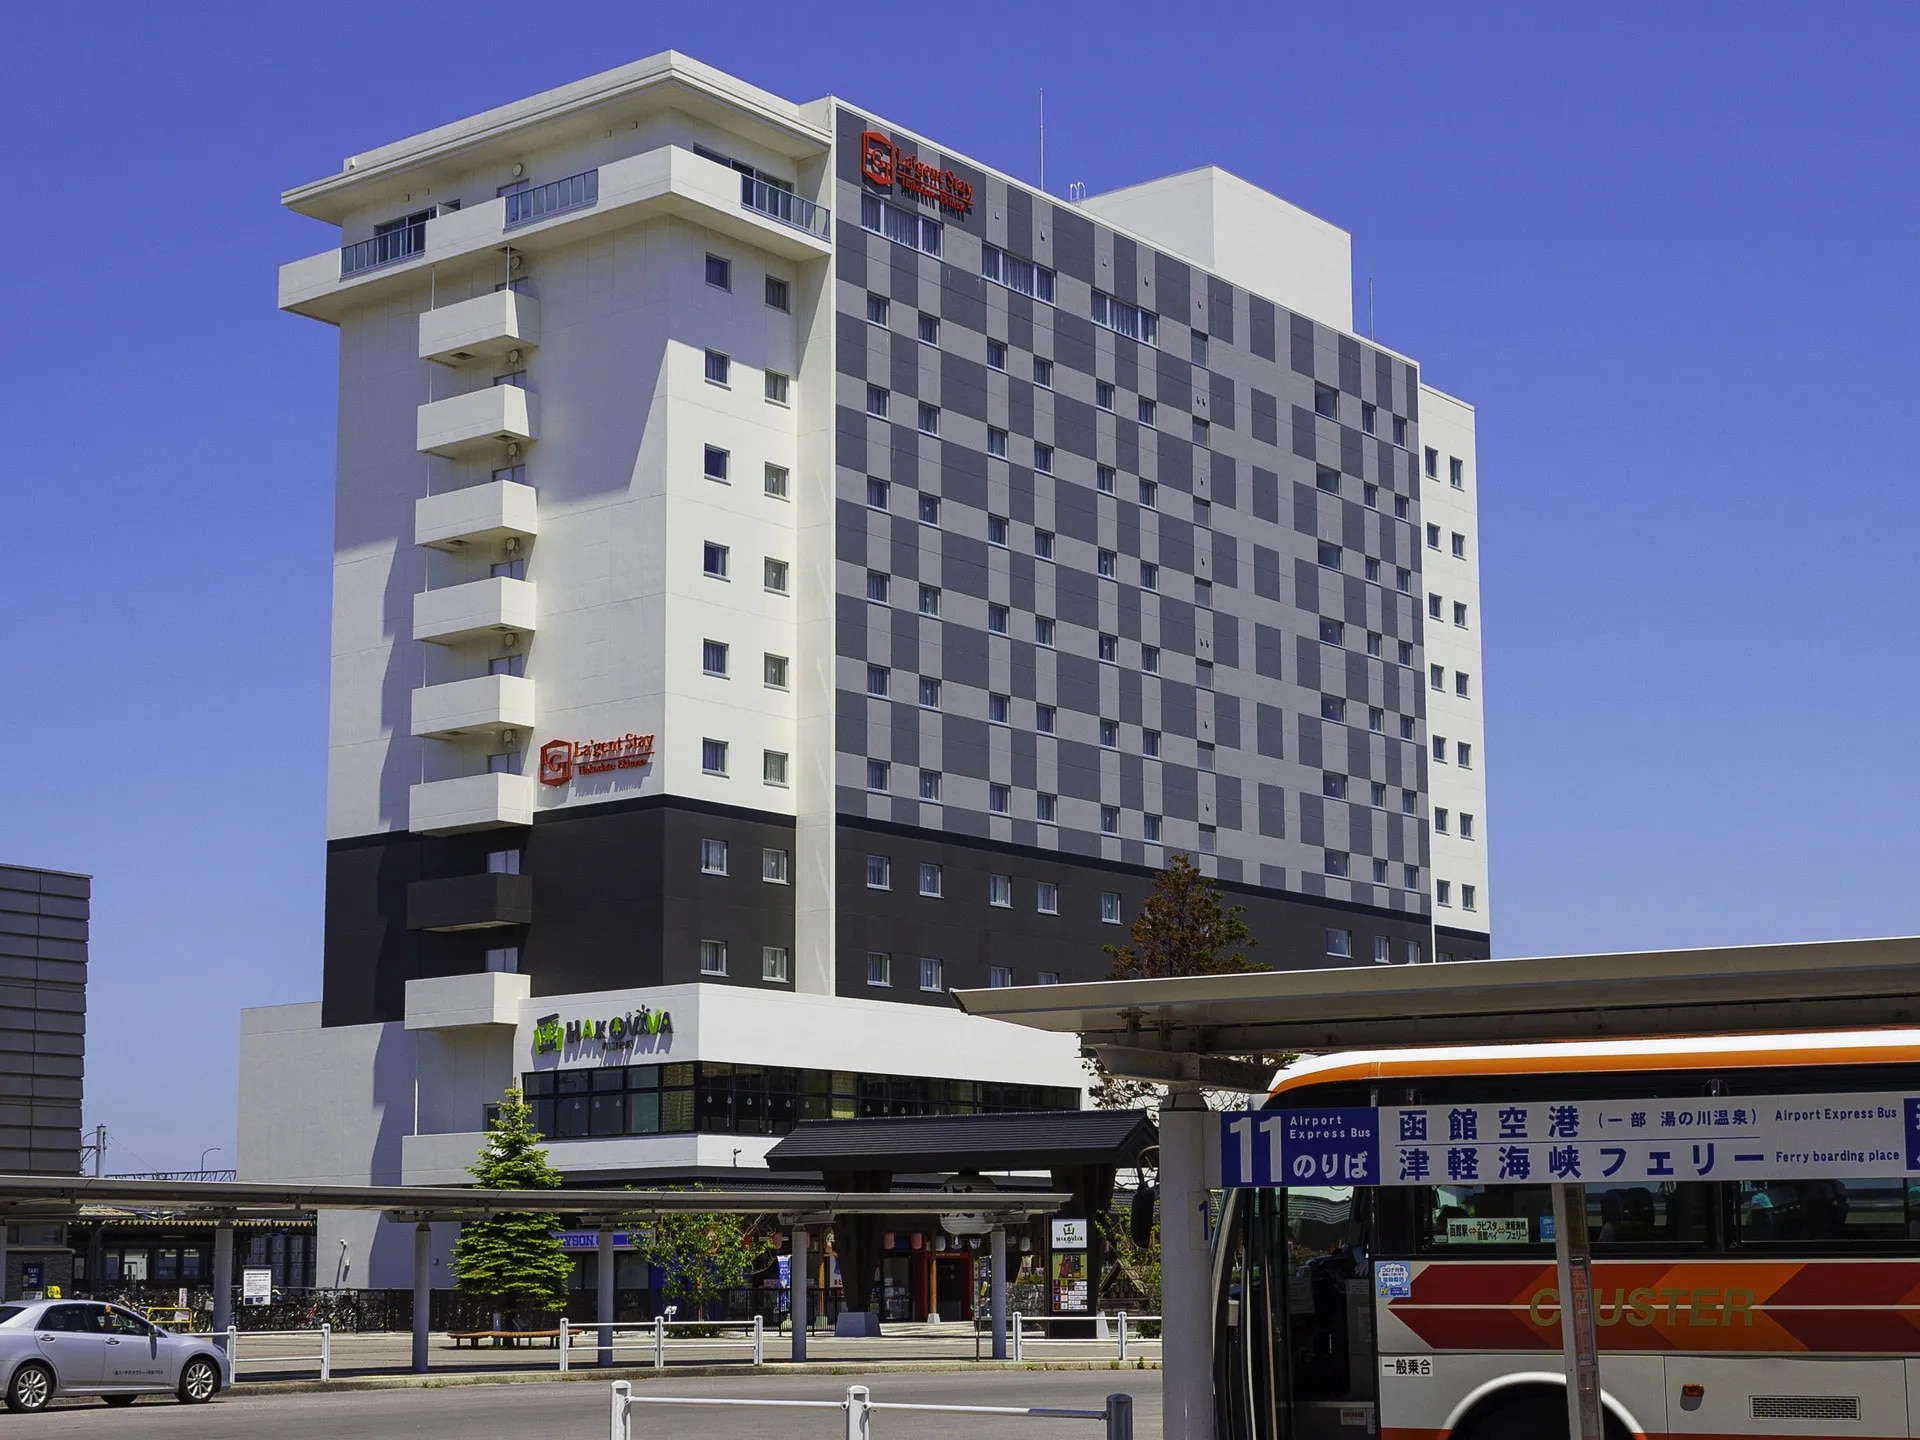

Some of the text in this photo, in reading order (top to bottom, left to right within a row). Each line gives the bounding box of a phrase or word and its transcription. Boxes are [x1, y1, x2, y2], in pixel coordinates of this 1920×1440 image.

[945, 169, 974, 200] Stay
[574, 733, 654, 757] La'gent Stay
[1290, 1115, 1342, 1127] Airport
[1290, 1127, 1371, 1141] Express Bus
[1399, 1105, 1579, 1142] 函館空港
[1775, 1107, 1822, 1122] Airport
[1825, 1106, 1874, 1121] Express
[1877, 1106, 1897, 1119] Bus
[1229, 1116, 1283, 1182] 11
[1399, 1143, 1900, 1181] 津軽海峡フェリー Ferry boarding place
[1293, 1151, 1368, 1179] のりば
[1530, 1288, 1755, 1327] CUSTER
[1384, 1358, 1431, 1374] 一般乗合
